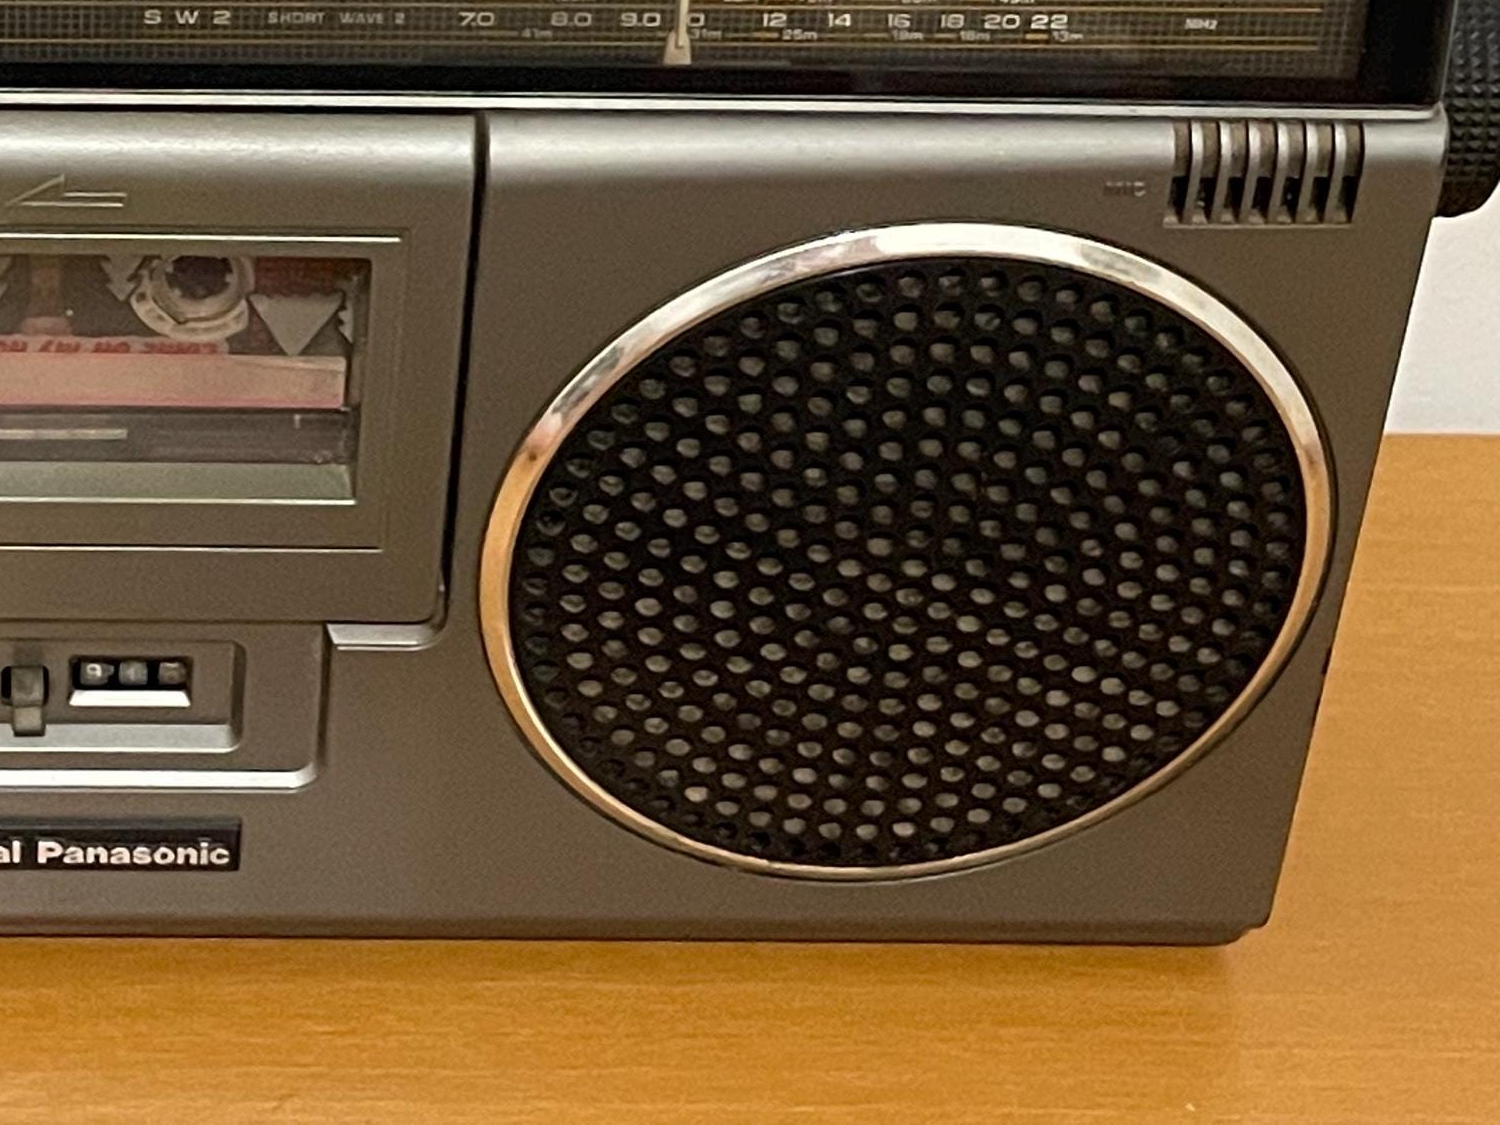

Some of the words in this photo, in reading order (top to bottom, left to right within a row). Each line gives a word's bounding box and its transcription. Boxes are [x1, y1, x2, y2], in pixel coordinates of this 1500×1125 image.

[268, 12, 325, 24] SHORT
[340, 12, 385, 24] WAVE
[458, 12, 495, 26] 7.0
[620, 12, 661, 27] 9.0
[762, 13, 788, 27] 12
[827, 13, 851, 27] 14
[887, 13, 912, 28] 16
[940, 14, 965, 28] 18
[984, 14, 1021, 29] 20
[1030, 15, 1069, 29] 22
[37, 839, 231, 867] Panasonic
